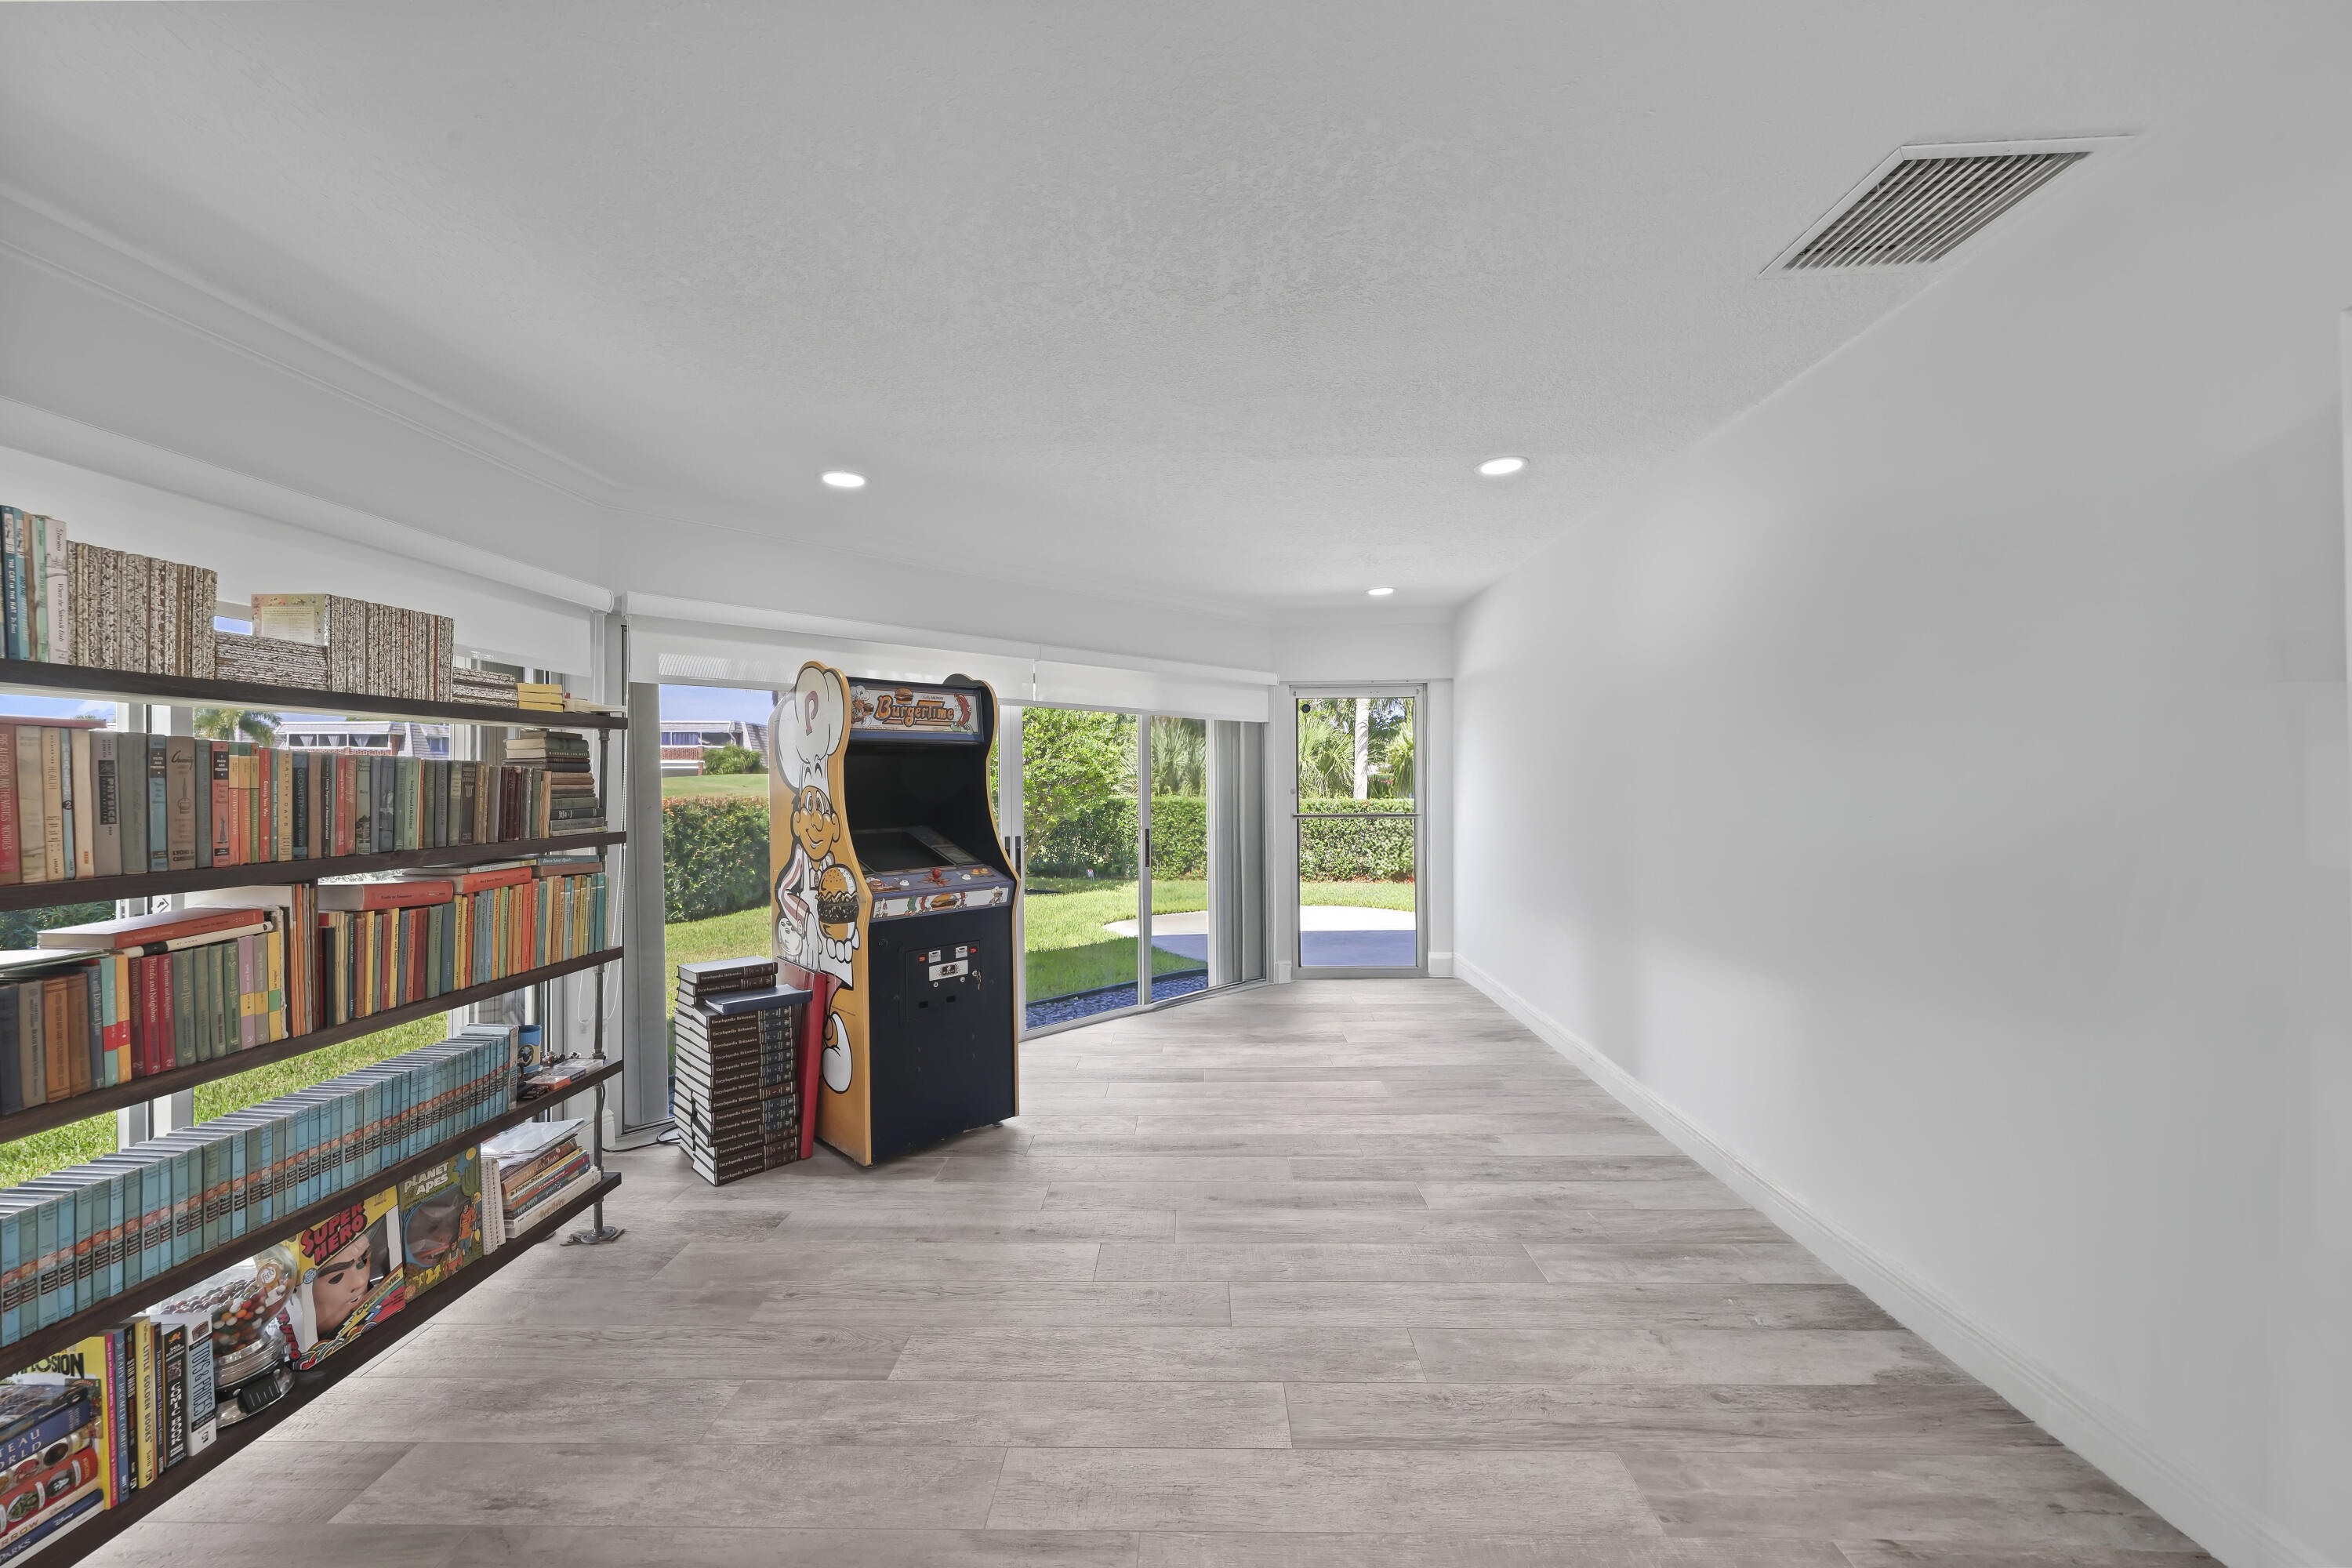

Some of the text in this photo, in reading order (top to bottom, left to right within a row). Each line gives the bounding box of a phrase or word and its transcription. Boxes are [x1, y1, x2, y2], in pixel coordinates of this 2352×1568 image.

[48, 766, 57, 789] HEALTH
[107, 778, 115, 822] PHYSICS
[148, 957, 157, 979] Friends
[148, 993, 157, 1022] Neighbors
[404, 1161, 449, 1193] PLANET
[416, 1173, 448, 1196] APES
[515, 1174, 543, 1193] Fisher-Price
[300, 1202, 366, 1258] SUPER
[314, 1214, 368, 1266] HERO
[356, 1273, 400, 1316] COSTUME
[191, 1343, 210, 1375] TOYS
[126, 1357, 136, 1398] STAR WARS
[194, 1371, 209, 1381] &
[192, 1377, 213, 1417] PRICES
[170, 1381, 183, 1446] COMIC BOOK
[53, 1512, 74, 1526] Disney
[0, 1538, 31, 1563] PARKS
